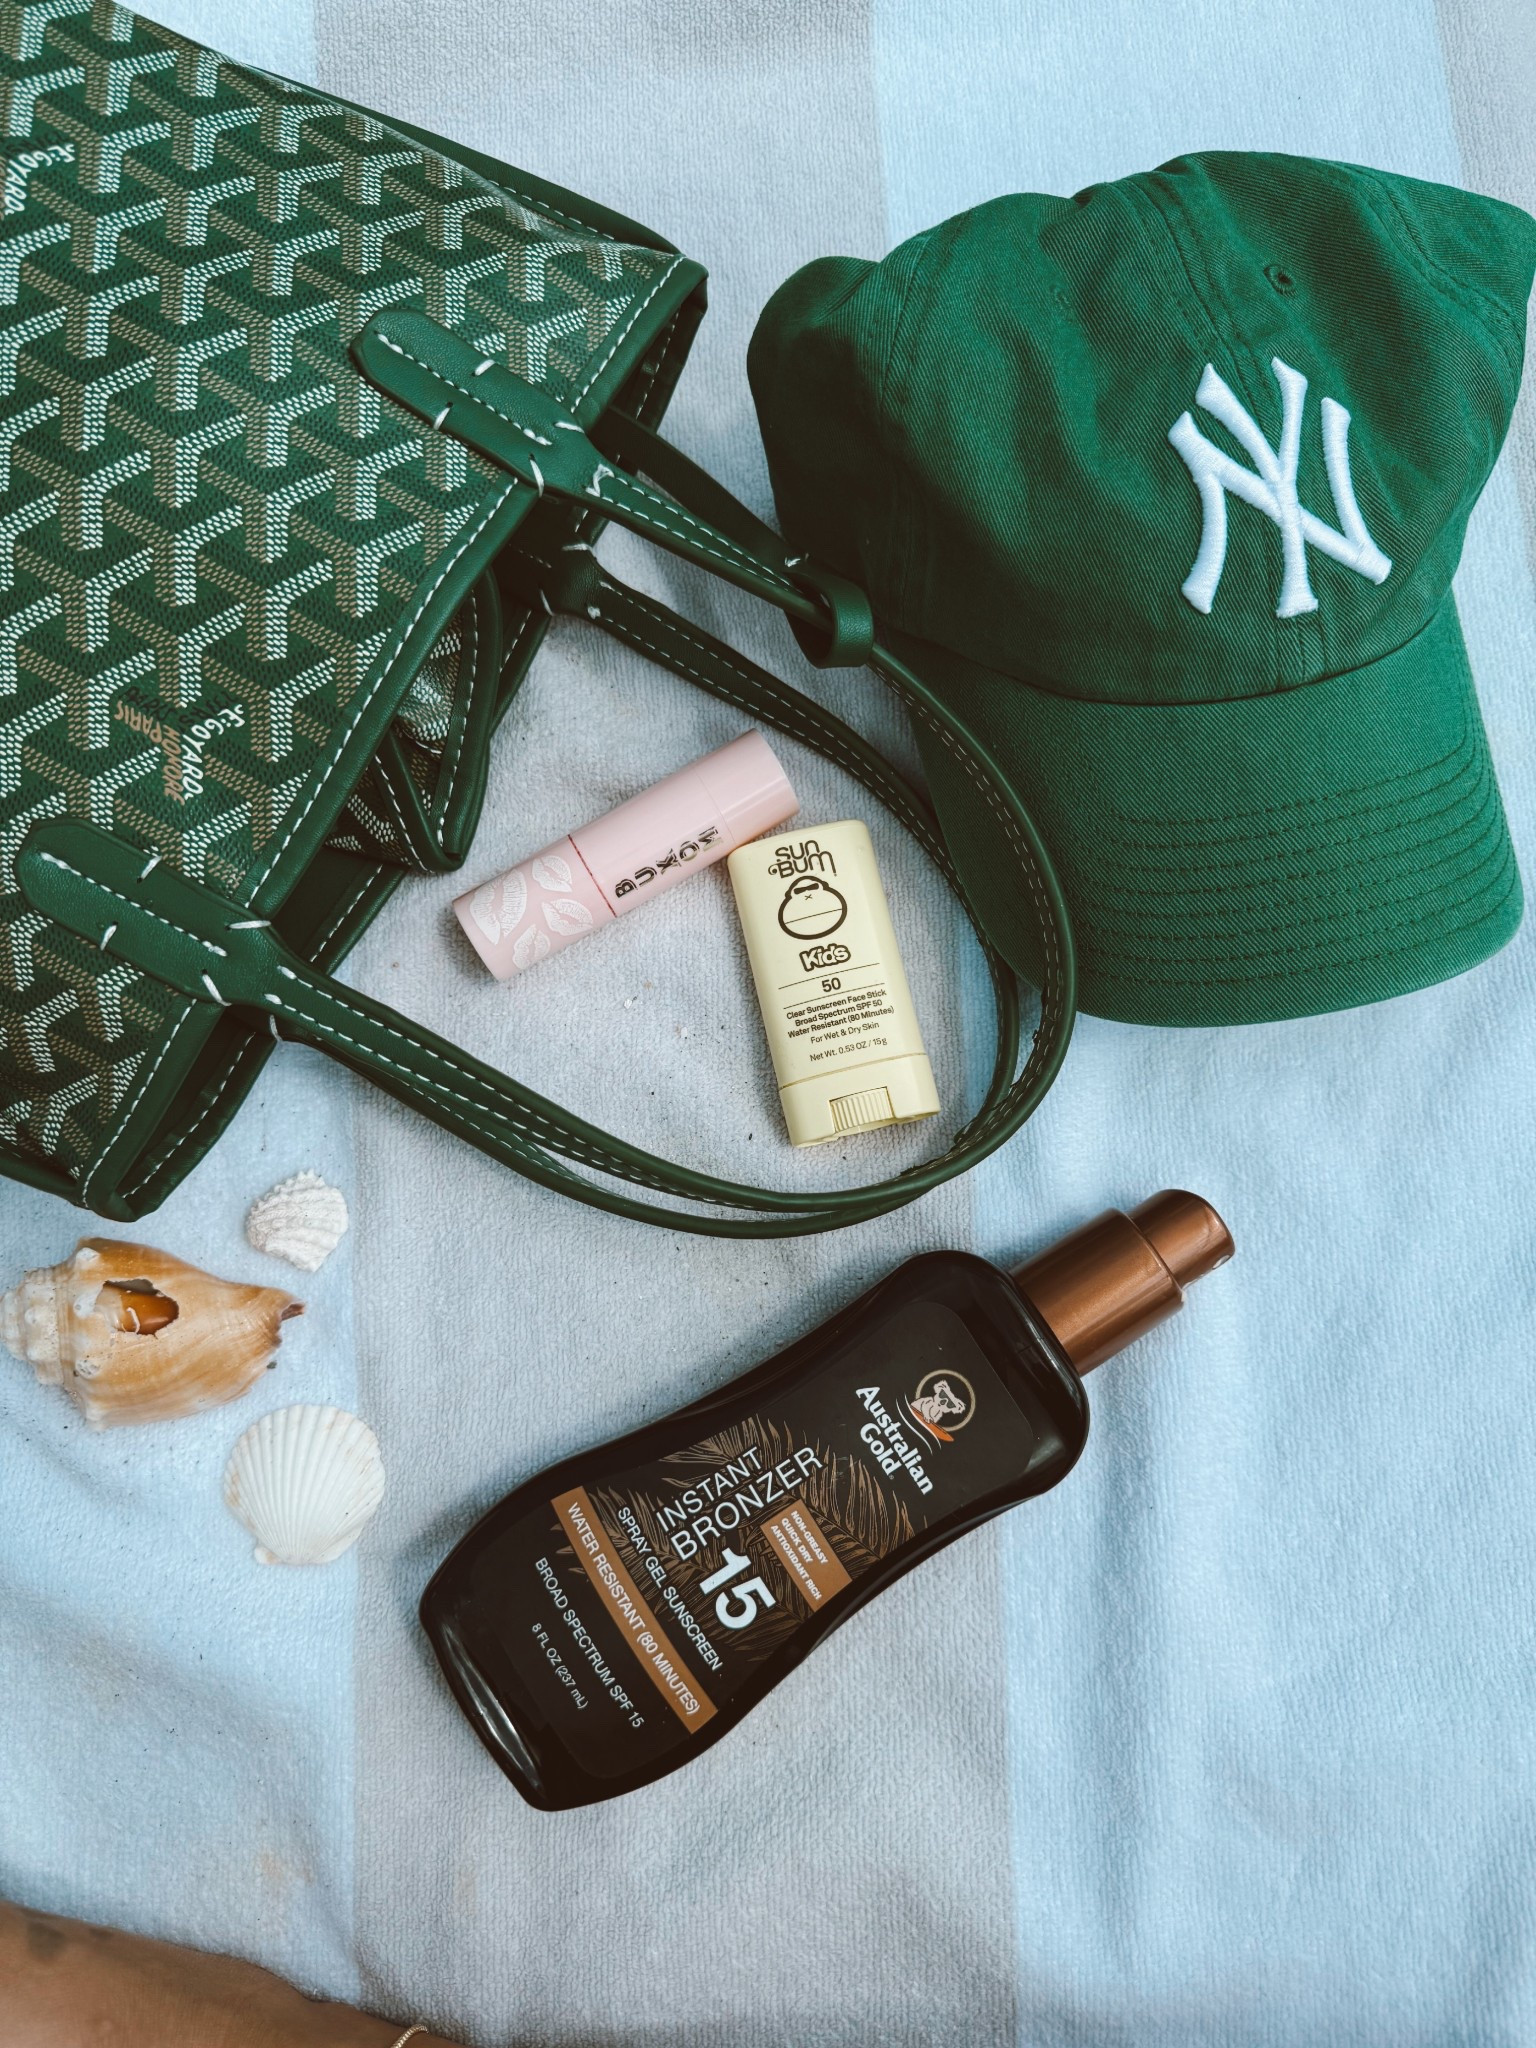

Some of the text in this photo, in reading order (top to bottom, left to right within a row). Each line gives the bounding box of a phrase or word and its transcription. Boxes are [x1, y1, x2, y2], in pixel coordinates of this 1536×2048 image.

[1168, 356, 1392, 618] NY
[114, 700, 162, 743] PARIS
[161, 724, 185, 805] HONORE
[615, 826, 723, 898] BUXOM
[799, 943, 852, 972] Kids
[821, 977, 842, 993] 50
[786, 989, 887, 1020] Clear Sunscreen Face Stick
[788, 1006, 895, 1039] Water Resistant (80 Minutes)
[795, 999, 883, 1027] Broad Spectrum SPF 50
[810, 1021, 880, 1044] For Wet & Dry Skin
[810, 1052, 824, 1062] Net
[824, 1048, 838, 1058] Wt.
[838, 1043, 855, 1055] 0.53
[855, 1040, 868, 1049] OZ
[855, 1386, 933, 1495] Australian
[860, 1422, 902, 1476] Gold
[656, 1446, 764, 1532] INSTANT
[670, 1447, 823, 1561] BRONZER
[770, 1525, 823, 1600] ANTIOXIDANT RICH
[781, 1517, 814, 1564] QUICK DRY
[791, 1510, 829, 1564] NON-GREASY
[567, 1502, 701, 1715] WATER RESISTANT (80 MINUTES)
[618, 1506, 723, 1671] SPRAY GEL SUNSCREEN
[699, 1547, 776, 1630] 15
[531, 1622, 588, 1709] 8 FL OZ (237 mL)
[535, 1557, 645, 1728] BROAD SPECTRUM SPF 15
